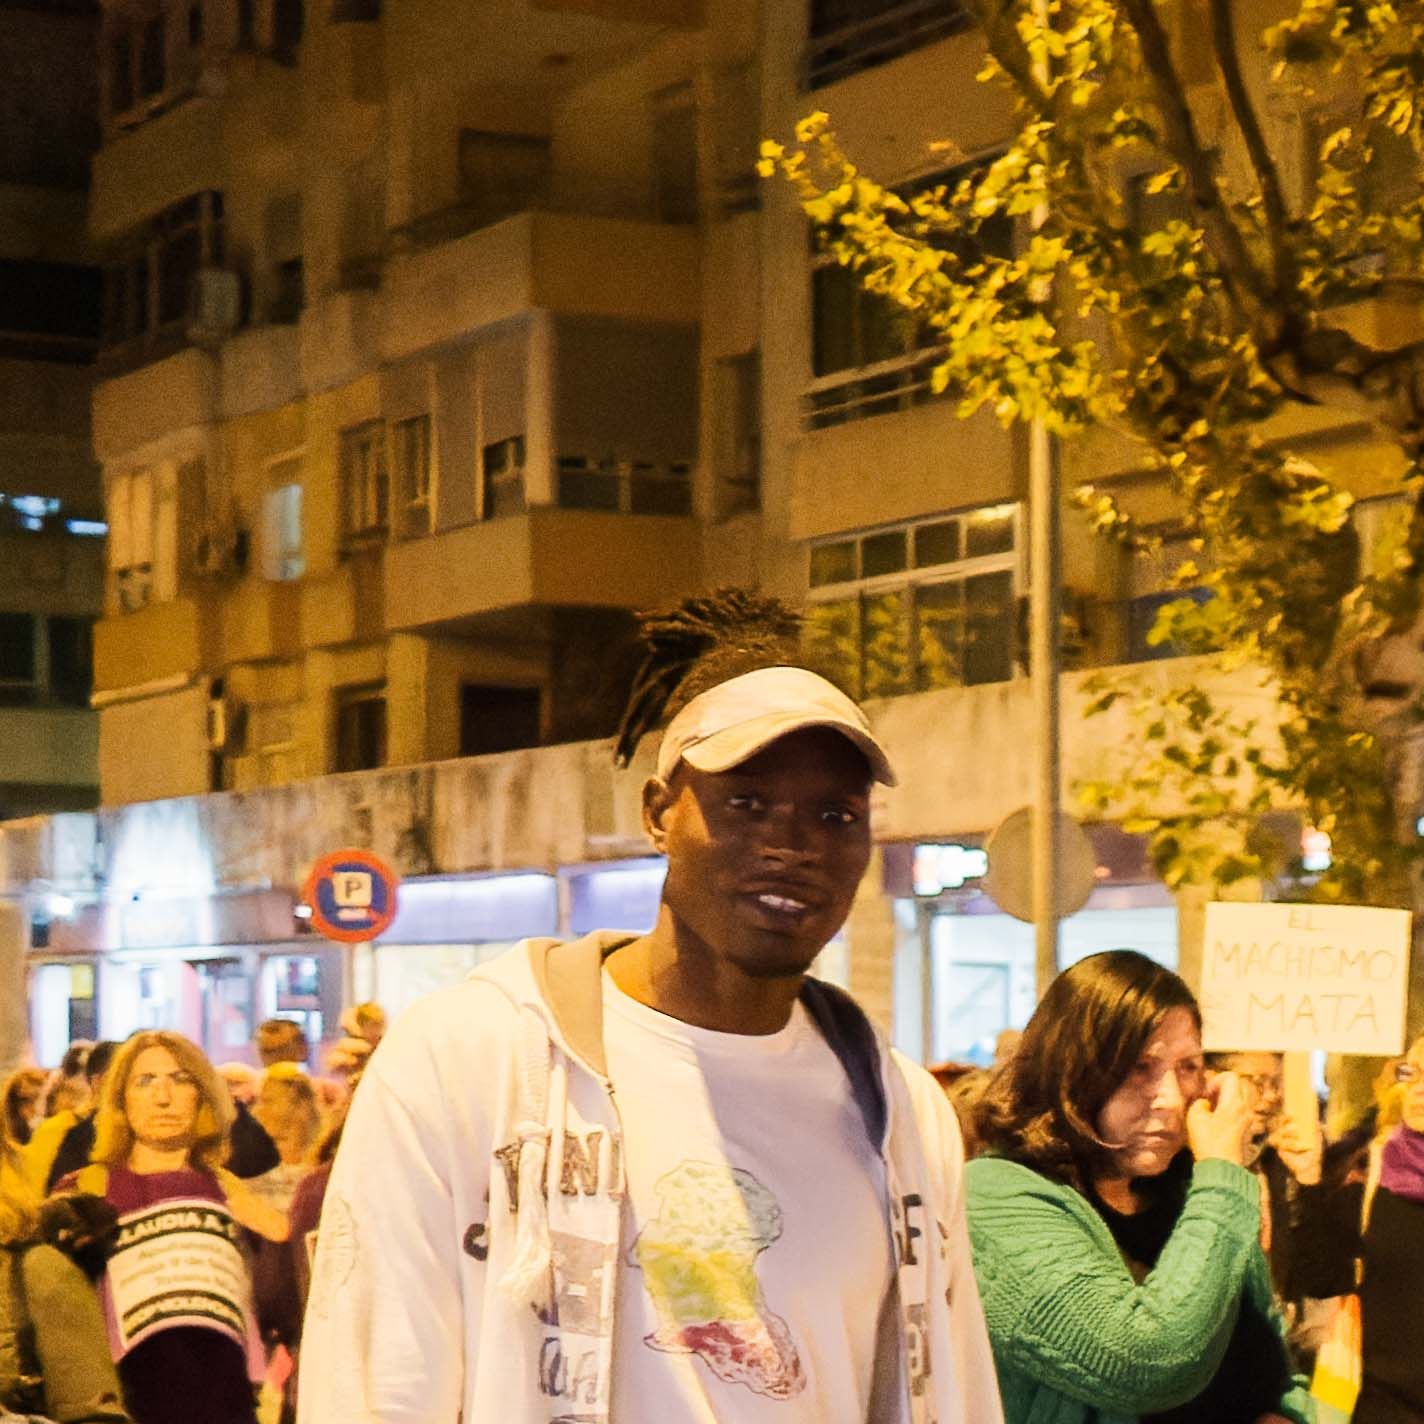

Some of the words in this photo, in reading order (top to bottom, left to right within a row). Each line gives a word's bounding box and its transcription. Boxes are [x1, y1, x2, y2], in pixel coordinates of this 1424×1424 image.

[344, 880, 362, 899] P
[1287, 908, 1324, 931] EL
[1209, 939, 1396, 983] MACHISMO
[1246, 991, 1379, 1036] MATA
